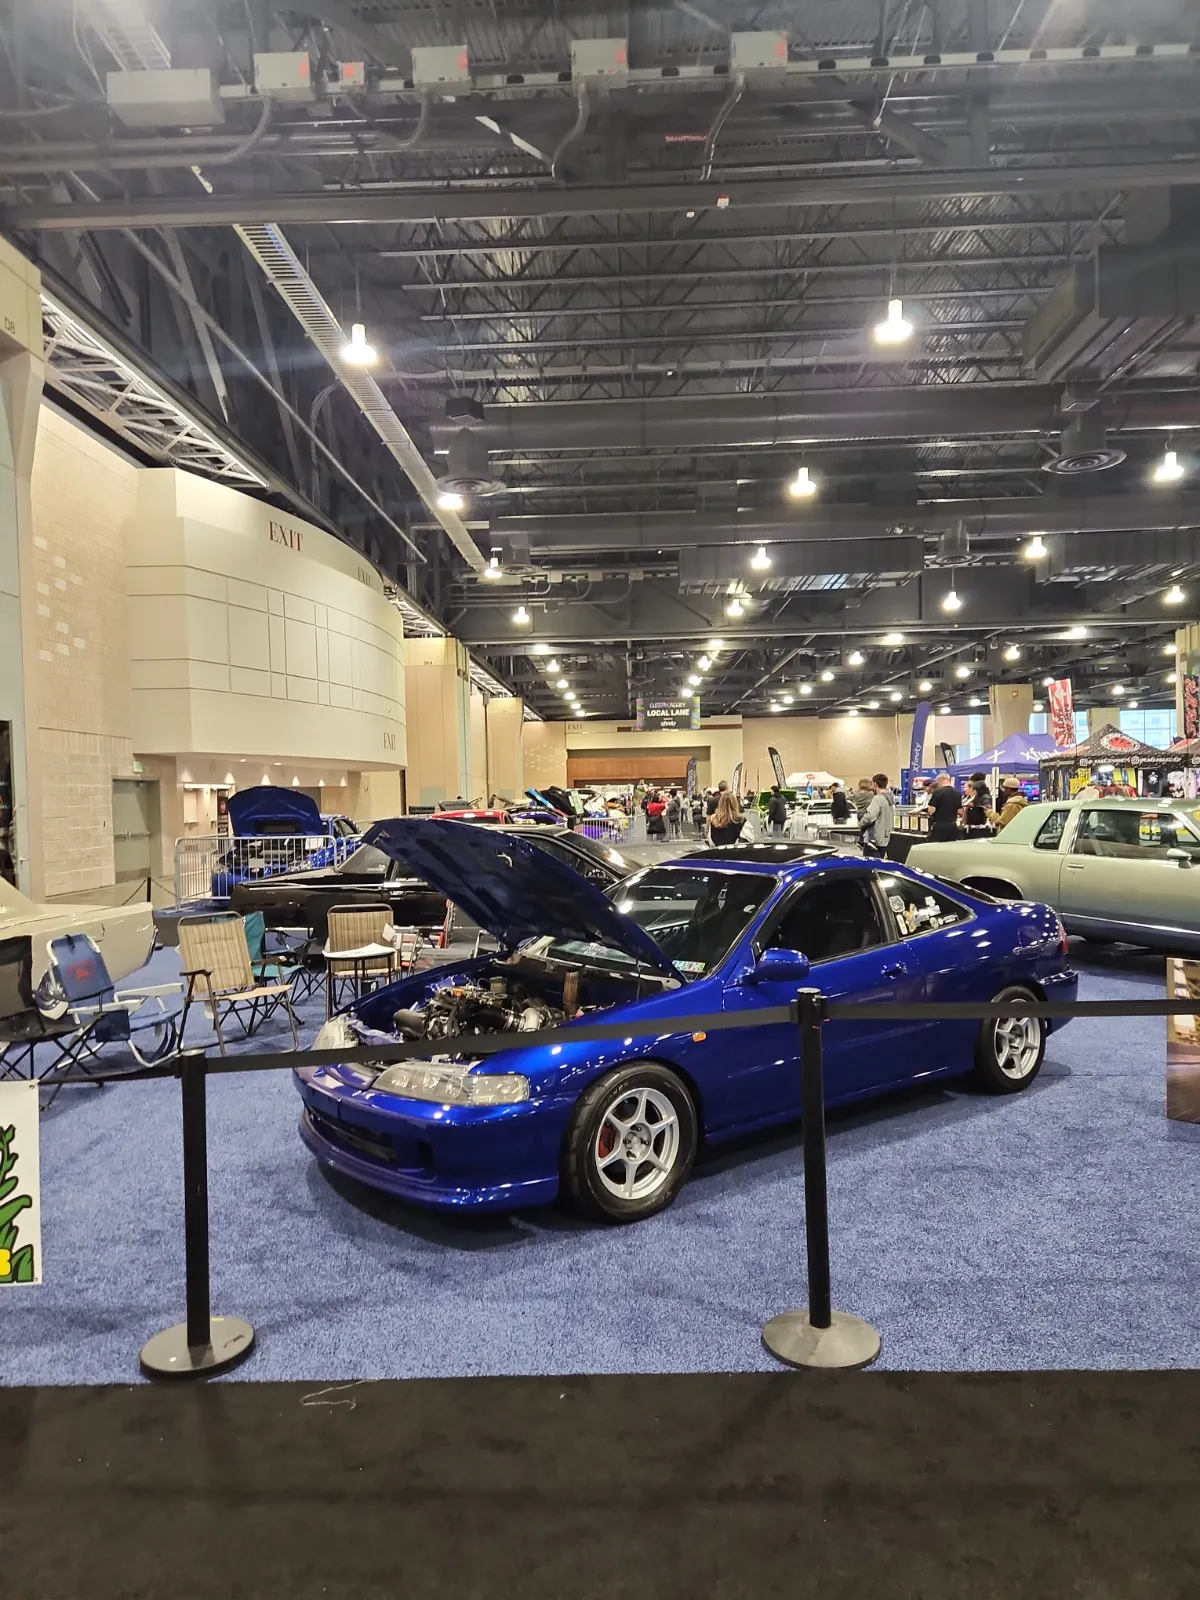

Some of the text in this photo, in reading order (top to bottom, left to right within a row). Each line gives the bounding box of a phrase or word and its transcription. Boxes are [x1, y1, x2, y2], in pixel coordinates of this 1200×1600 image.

[269, 521, 303, 552] EXIT
[383, 732, 396, 750] EXIT
[912, 742, 922, 772] xfinity
